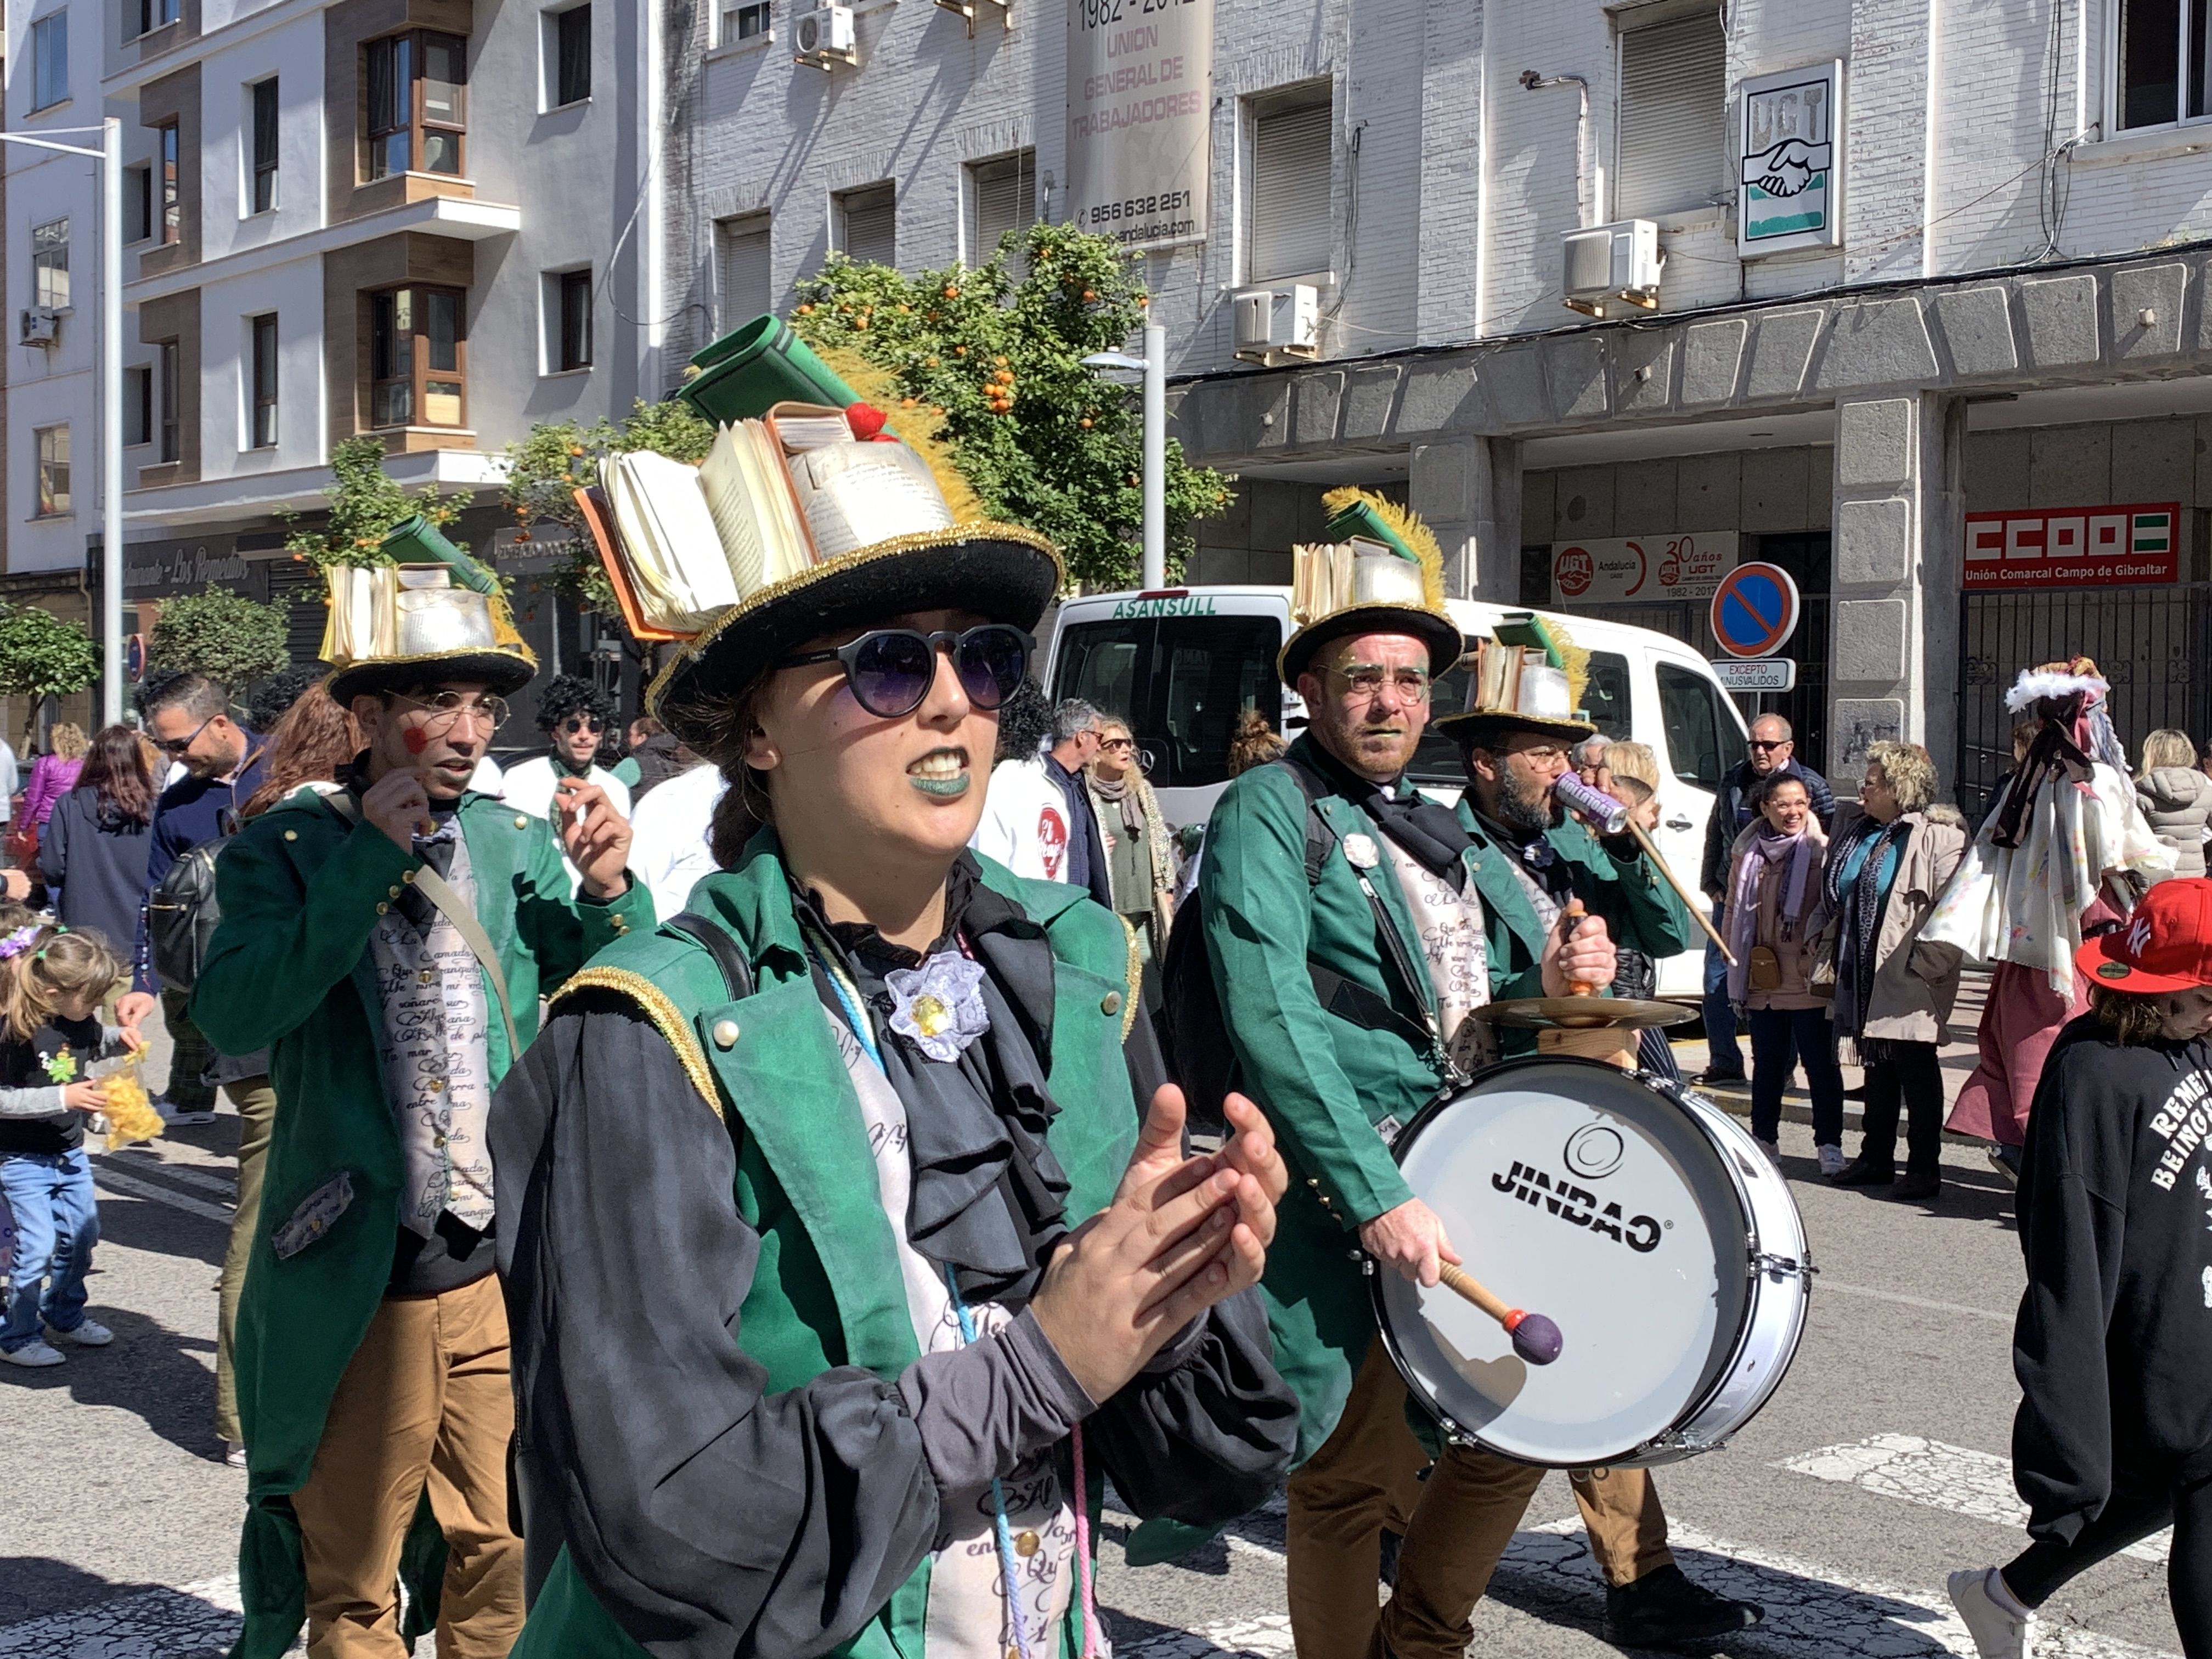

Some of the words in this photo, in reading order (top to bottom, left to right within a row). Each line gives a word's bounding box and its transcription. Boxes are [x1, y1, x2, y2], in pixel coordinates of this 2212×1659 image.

[1079, 0, 1122, 31] 1982
[1107, 25, 1158, 58] UNION
[1084, 63, 1157, 100] GENERAL
[1160, 56, 1184, 83] DE
[1072, 90, 1201, 139] TRABAJADORES
[1752, 87, 1824, 150] UGT
[1091, 202, 1121, 224] 956
[1125, 196, 1156, 218] 632
[1160, 190, 1190, 211] 251
[1110, 219, 1194, 243] -andalucia.com
[1966, 514, 2128, 561] CCOO
[171, 549, 193, 584] Los
[195, 546, 250, 583] Remedios
[1559, 555, 1588, 574] UGT
[1689, 565, 1716, 574] UGT
[1693, 551, 1723, 562] años
[1966, 569, 1997, 580] Unión
[2000, 567, 2052, 579] Comarcal
[2055, 567, 2094, 579] Campo
[2098, 565, 2112, 577] de
[2115, 564, 2168, 577] Gibraltar
[1112, 596, 1216, 619] ASANSULL
[1667, 587, 1687, 597] 1982
[1729, 664, 1768, 675] EXCEPTO
[1558, 777, 1613, 818] EVOLUTION
[2151, 1108, 2208, 1192] BEING
[1491, 1160, 1662, 1254] JINBAO
